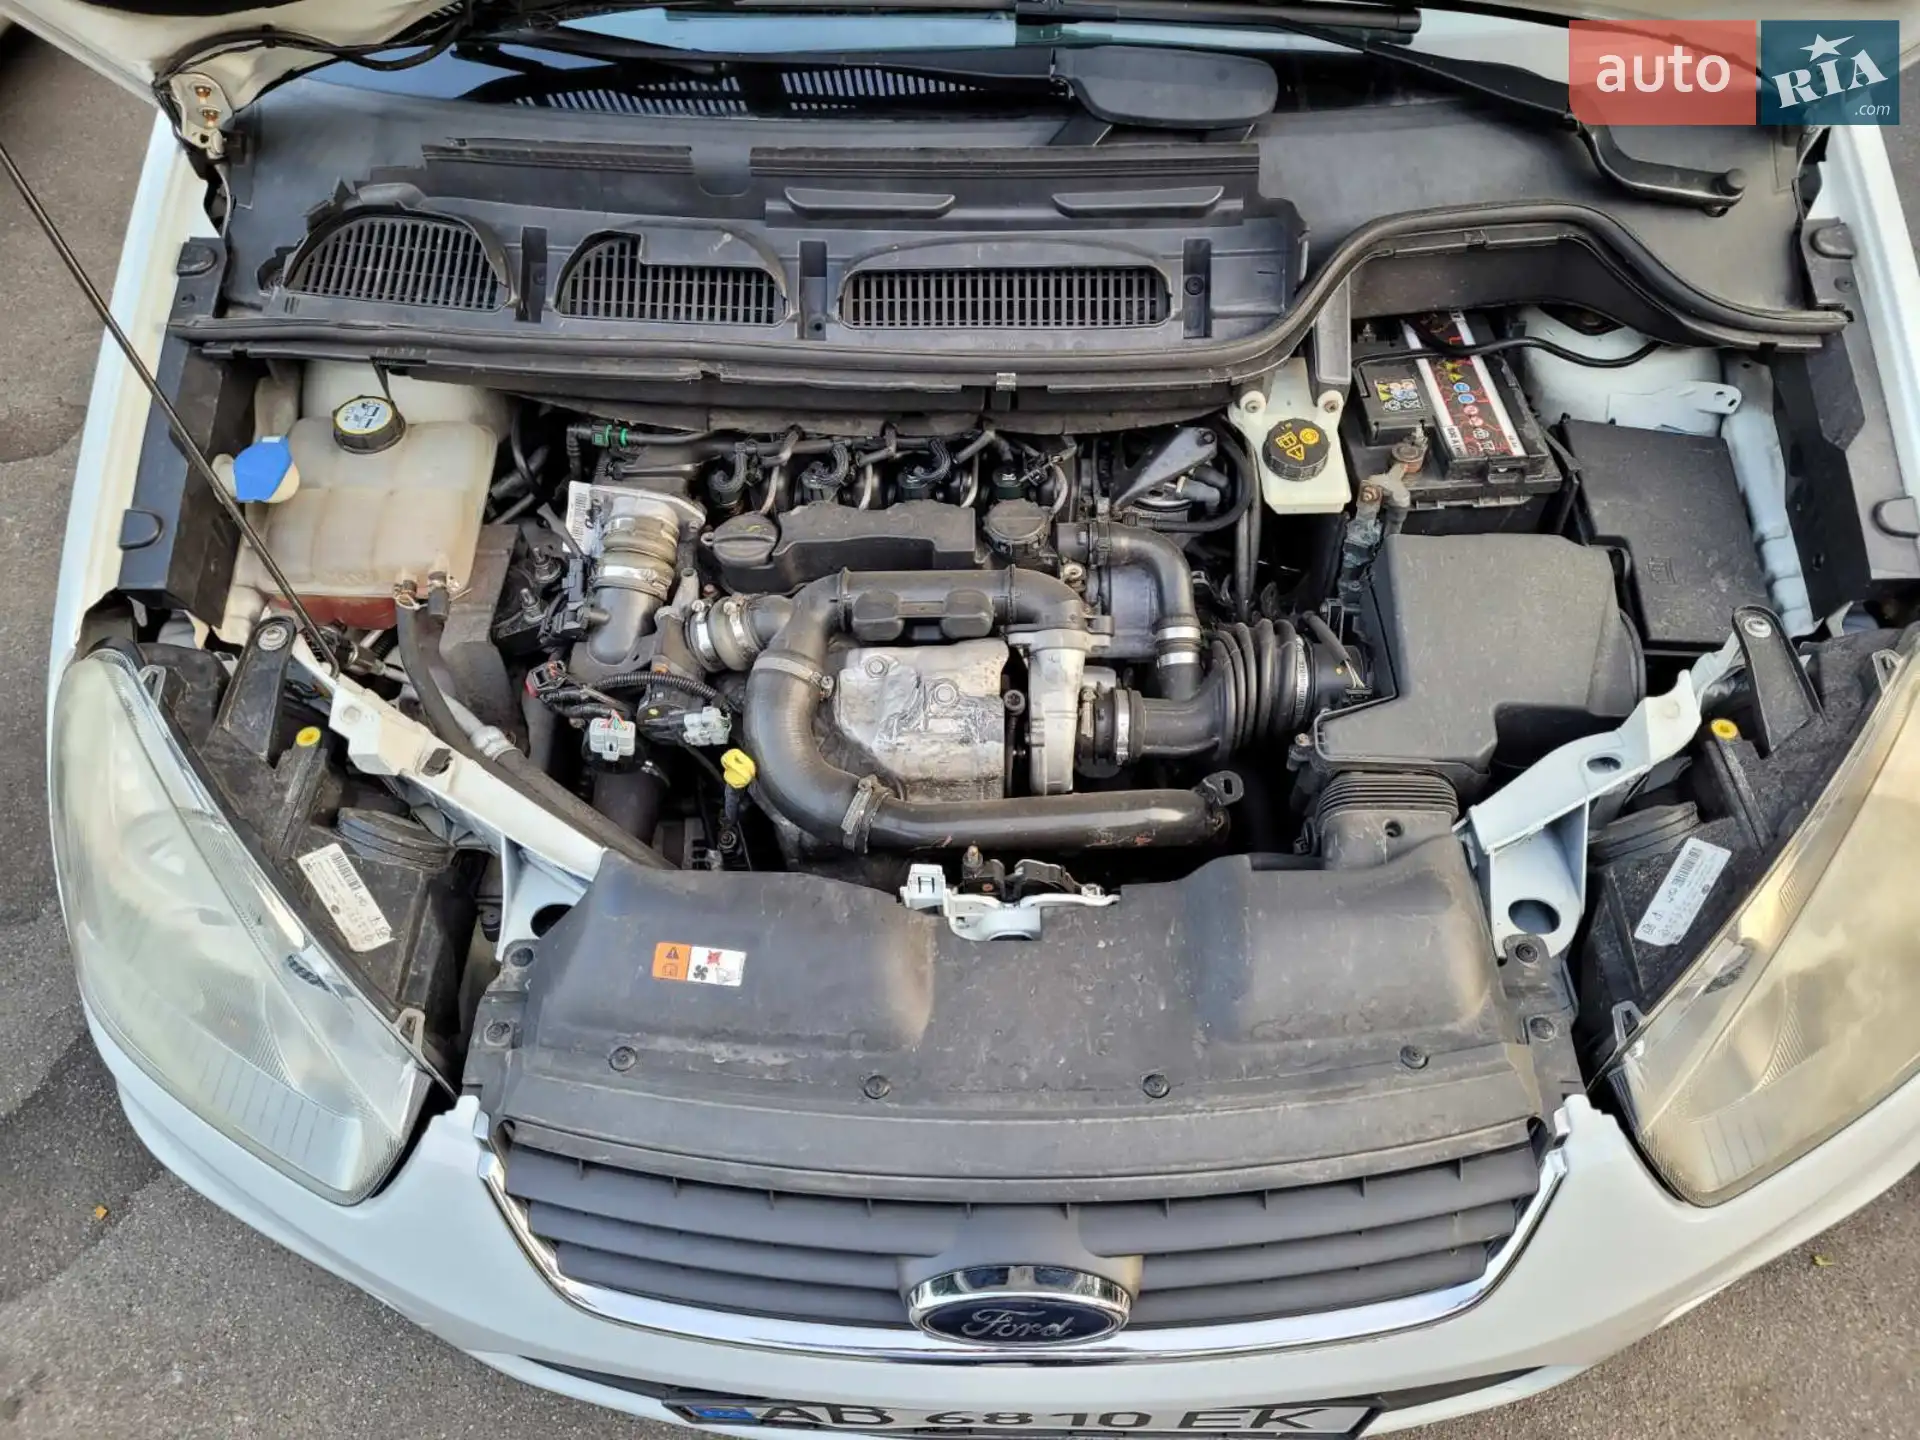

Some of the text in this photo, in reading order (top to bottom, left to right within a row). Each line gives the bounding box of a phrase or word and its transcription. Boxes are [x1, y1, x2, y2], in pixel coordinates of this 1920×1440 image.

[961, 1308, 1074, 1338] Ford
[759, 1404, 1331, 1430] AB 6810 EK
